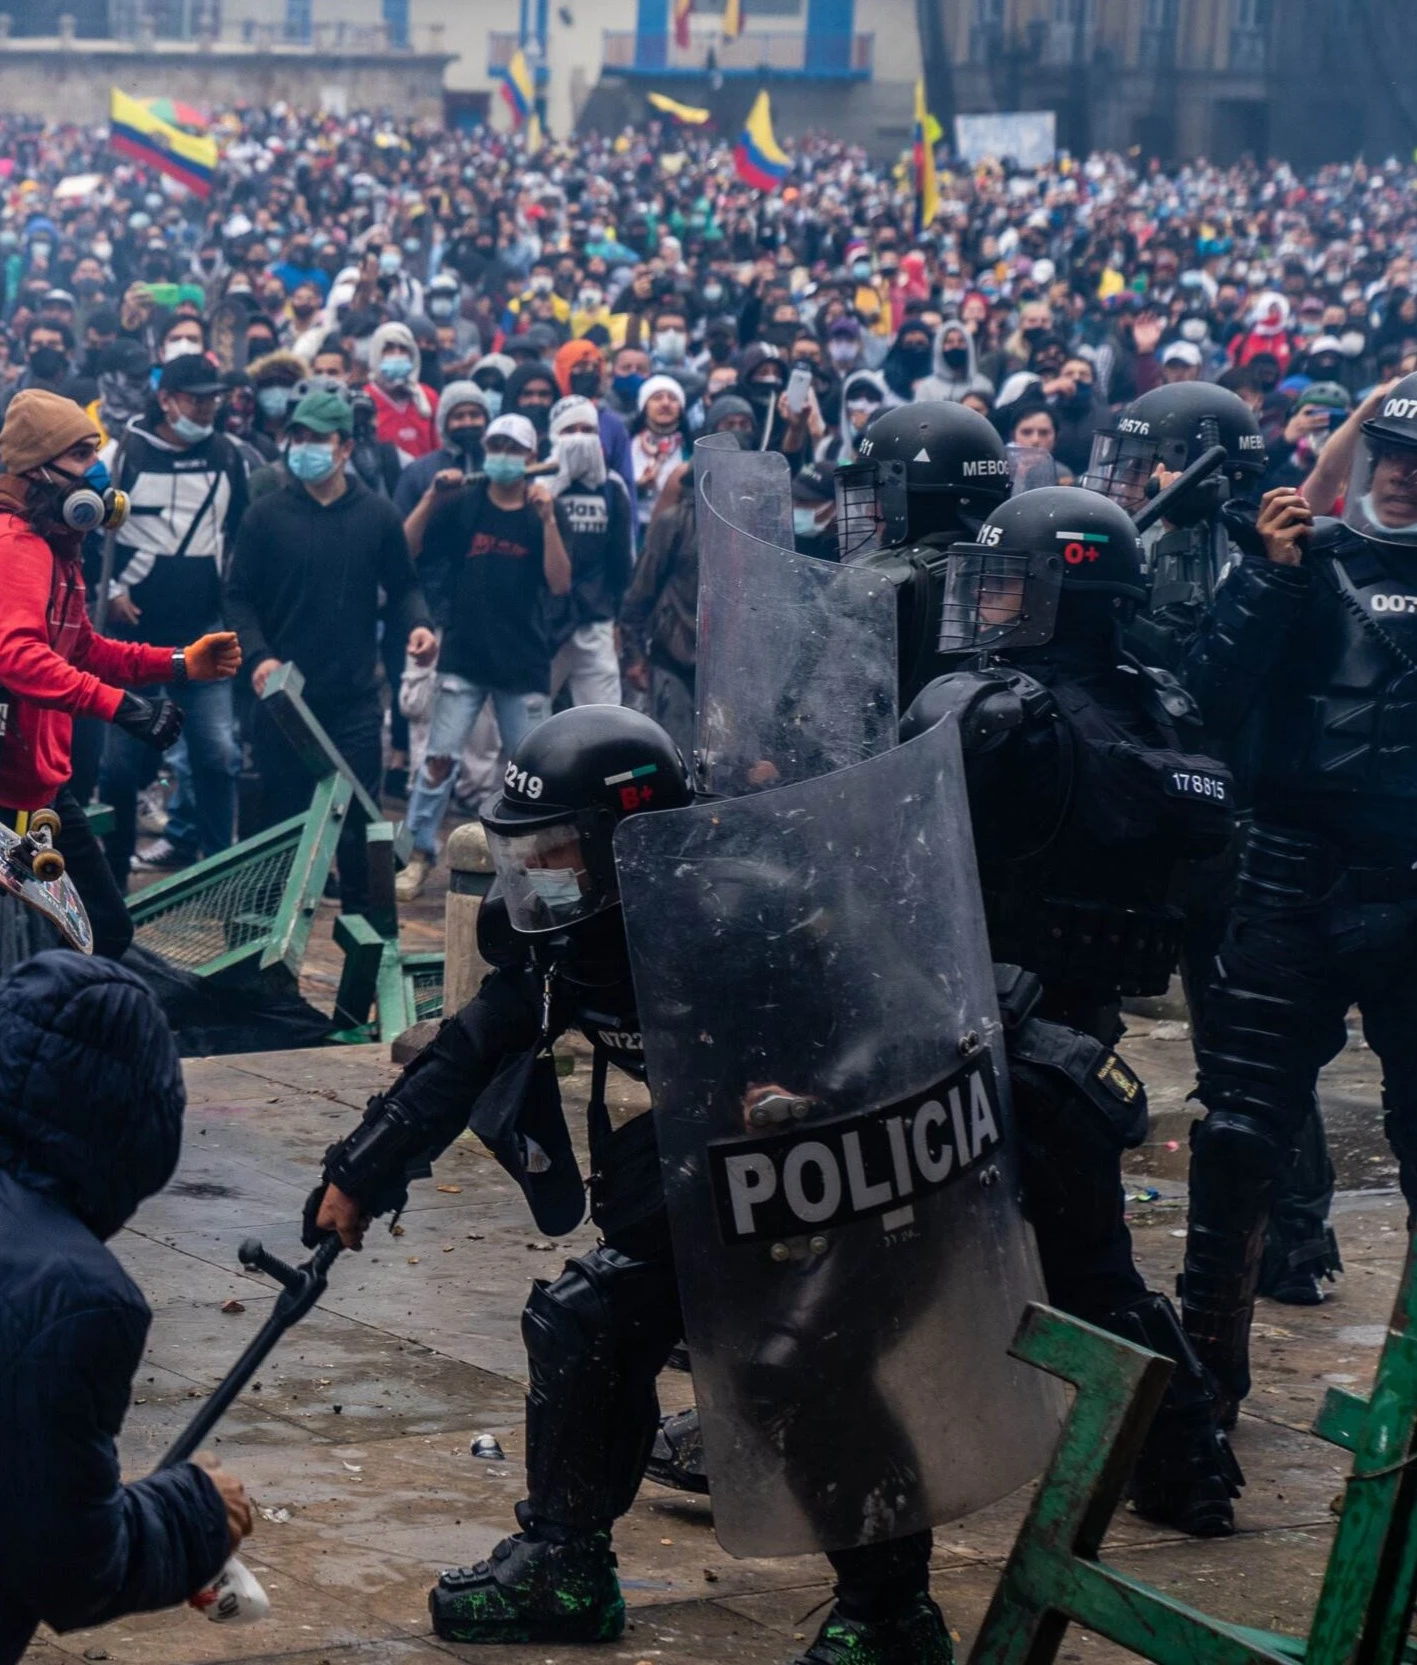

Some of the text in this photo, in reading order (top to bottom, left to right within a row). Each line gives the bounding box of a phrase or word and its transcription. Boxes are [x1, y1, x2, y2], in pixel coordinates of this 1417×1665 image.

[619, 784, 653, 811] B+
[1171, 772, 1225, 800] 178815
[724, 1069, 1000, 1236] POLICIA
